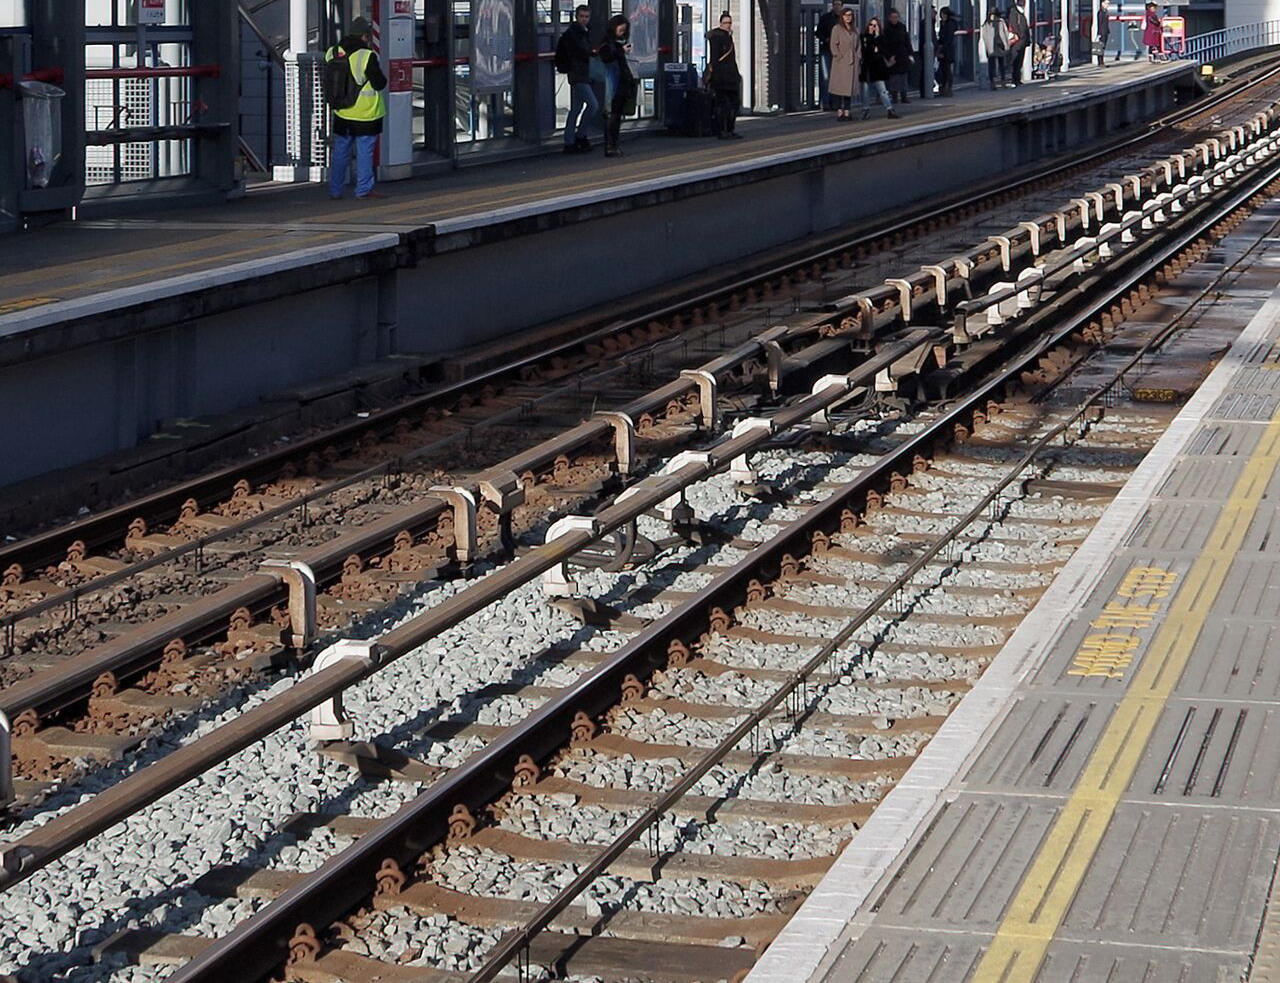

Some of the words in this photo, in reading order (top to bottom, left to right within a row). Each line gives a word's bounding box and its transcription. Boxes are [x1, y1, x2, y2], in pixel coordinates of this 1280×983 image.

[1117, 567, 1178, 599] STEP
[1089, 601, 1161, 629] THE
[1067, 633, 1142, 678] MIND
